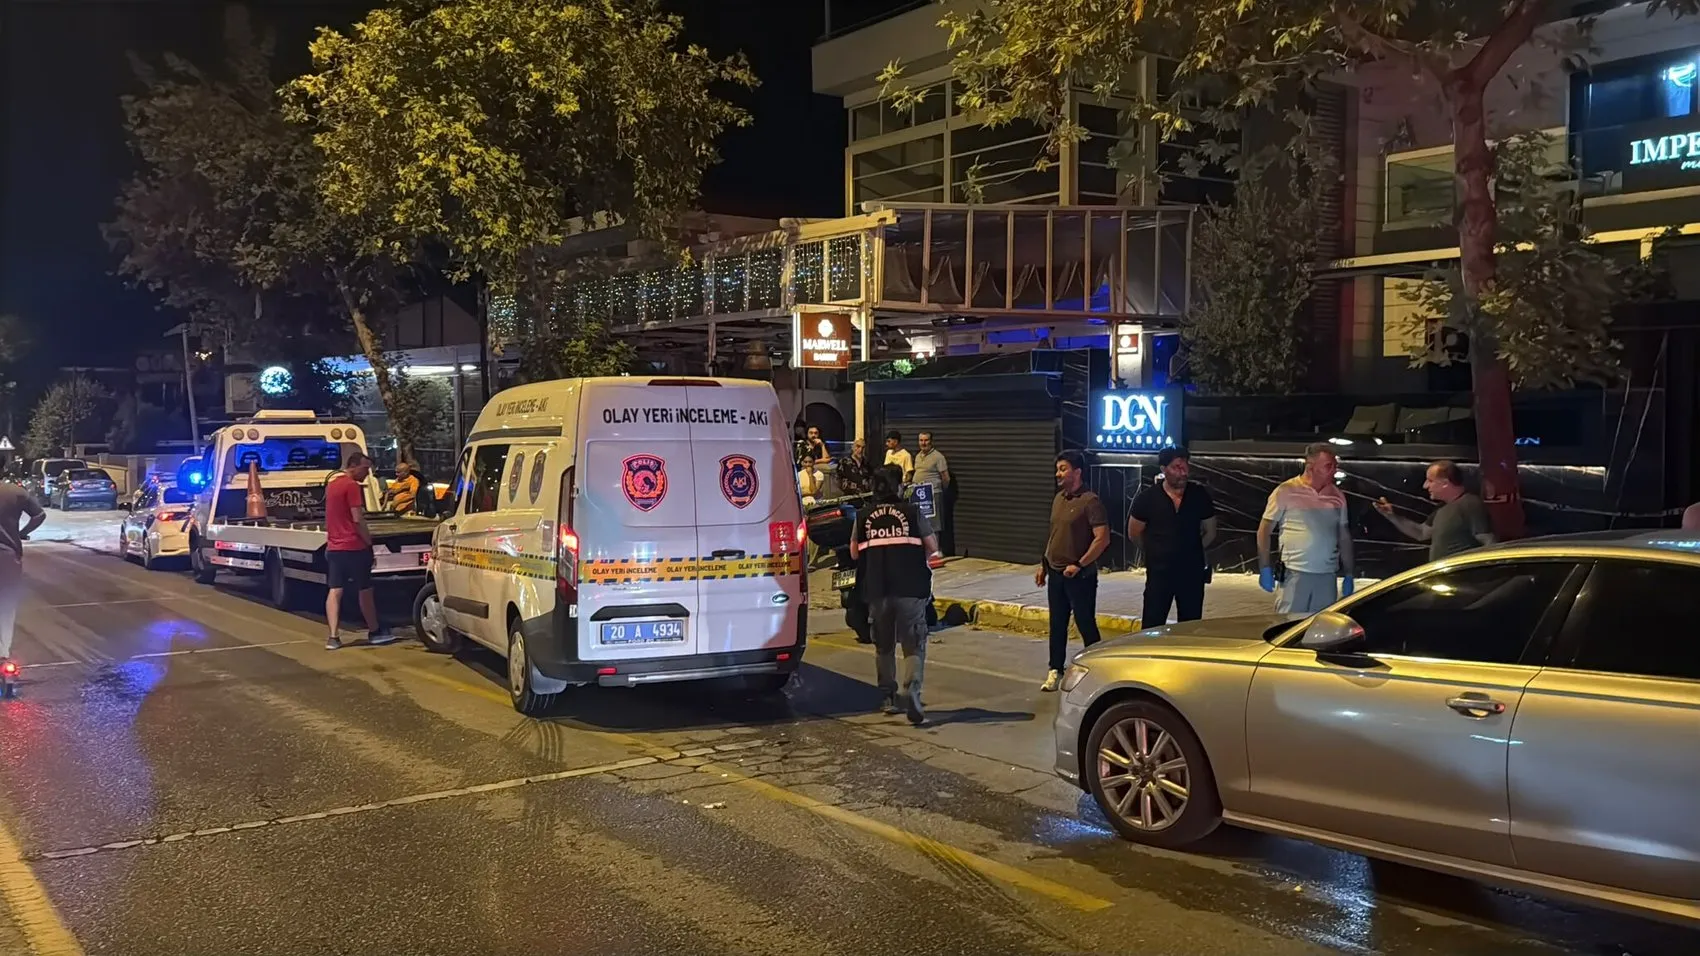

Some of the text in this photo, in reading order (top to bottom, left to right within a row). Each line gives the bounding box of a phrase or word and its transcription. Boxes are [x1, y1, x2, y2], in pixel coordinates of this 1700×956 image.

[602, 408, 639, 424] OLAY
[1102, 395, 1165, 432] DGN
[667, 565, 682, 573] OLAY
[610, 623, 680, 639] 20 A 4934
